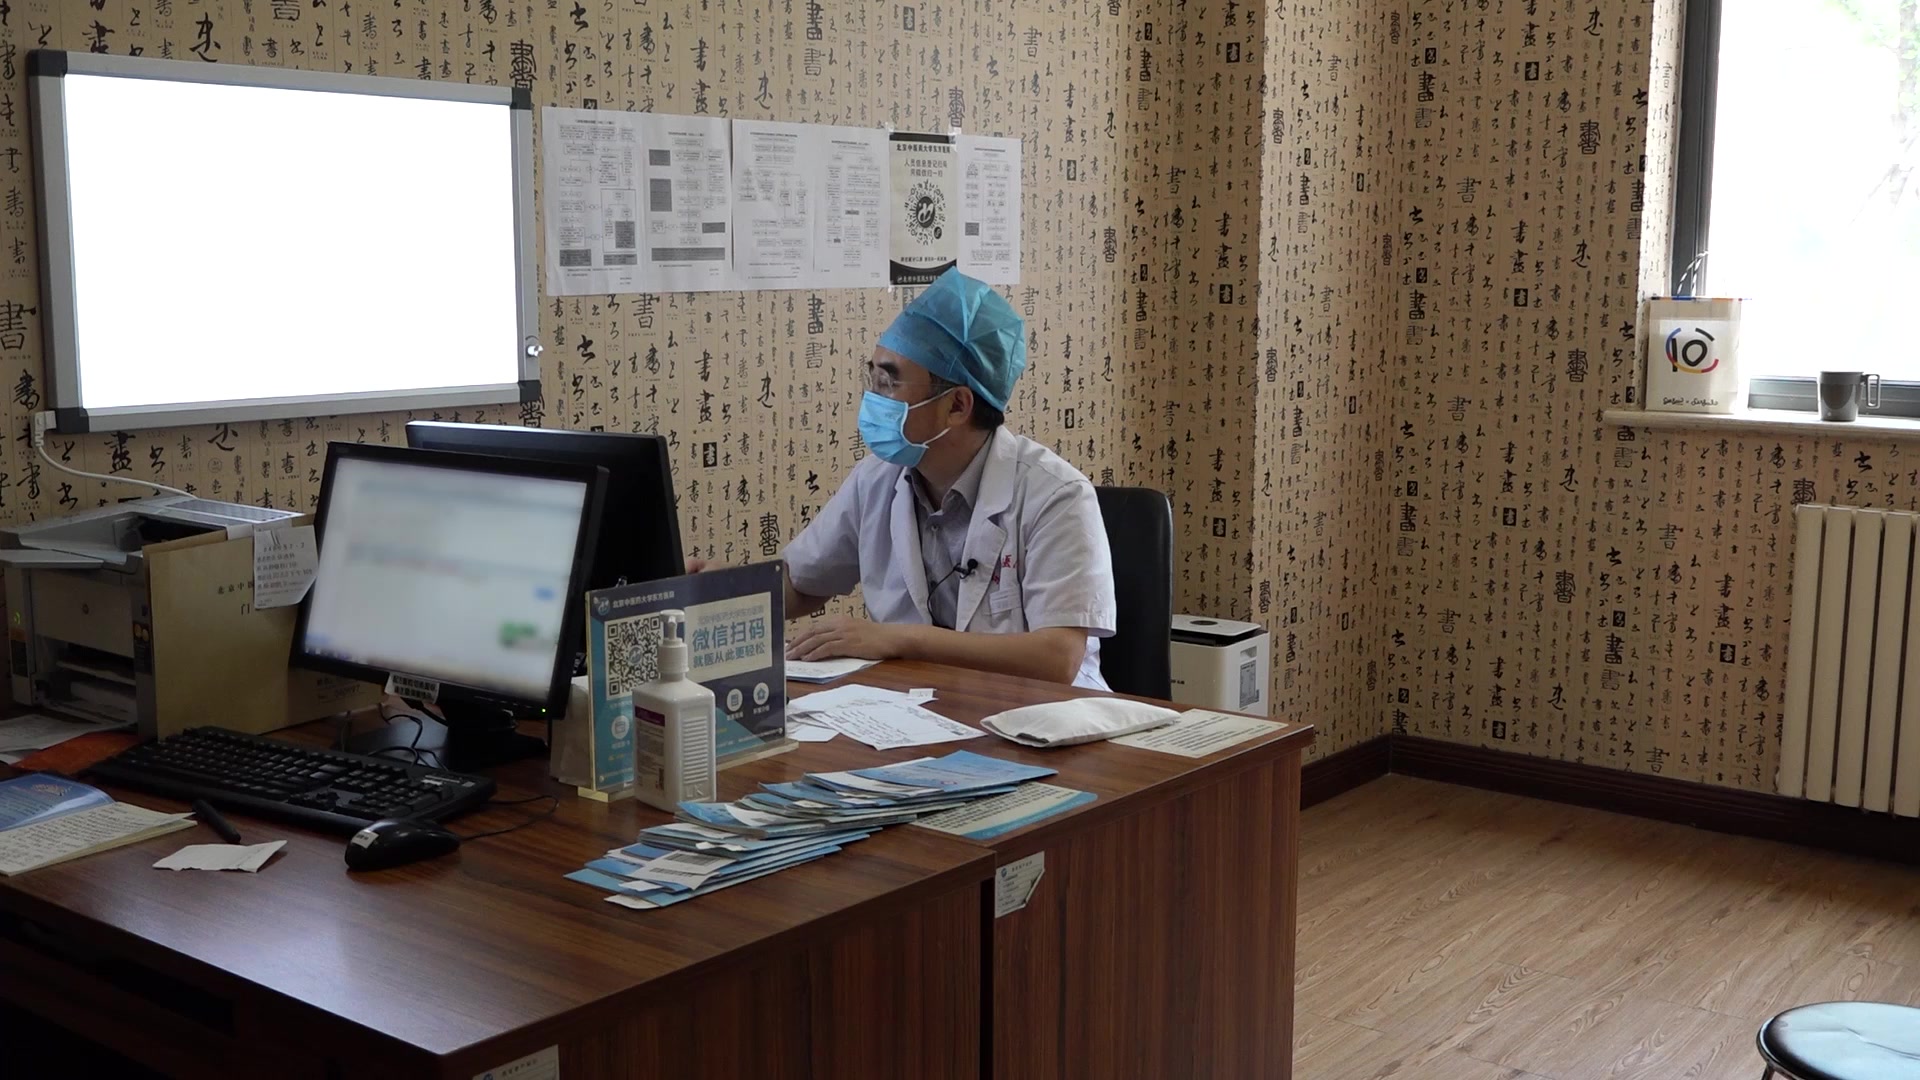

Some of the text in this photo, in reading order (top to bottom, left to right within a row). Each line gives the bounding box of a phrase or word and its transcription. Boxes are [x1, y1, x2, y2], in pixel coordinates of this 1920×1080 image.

[692, 617, 765, 652] 微信扫码
[693, 641, 765, 668] 就医从此更轻松
